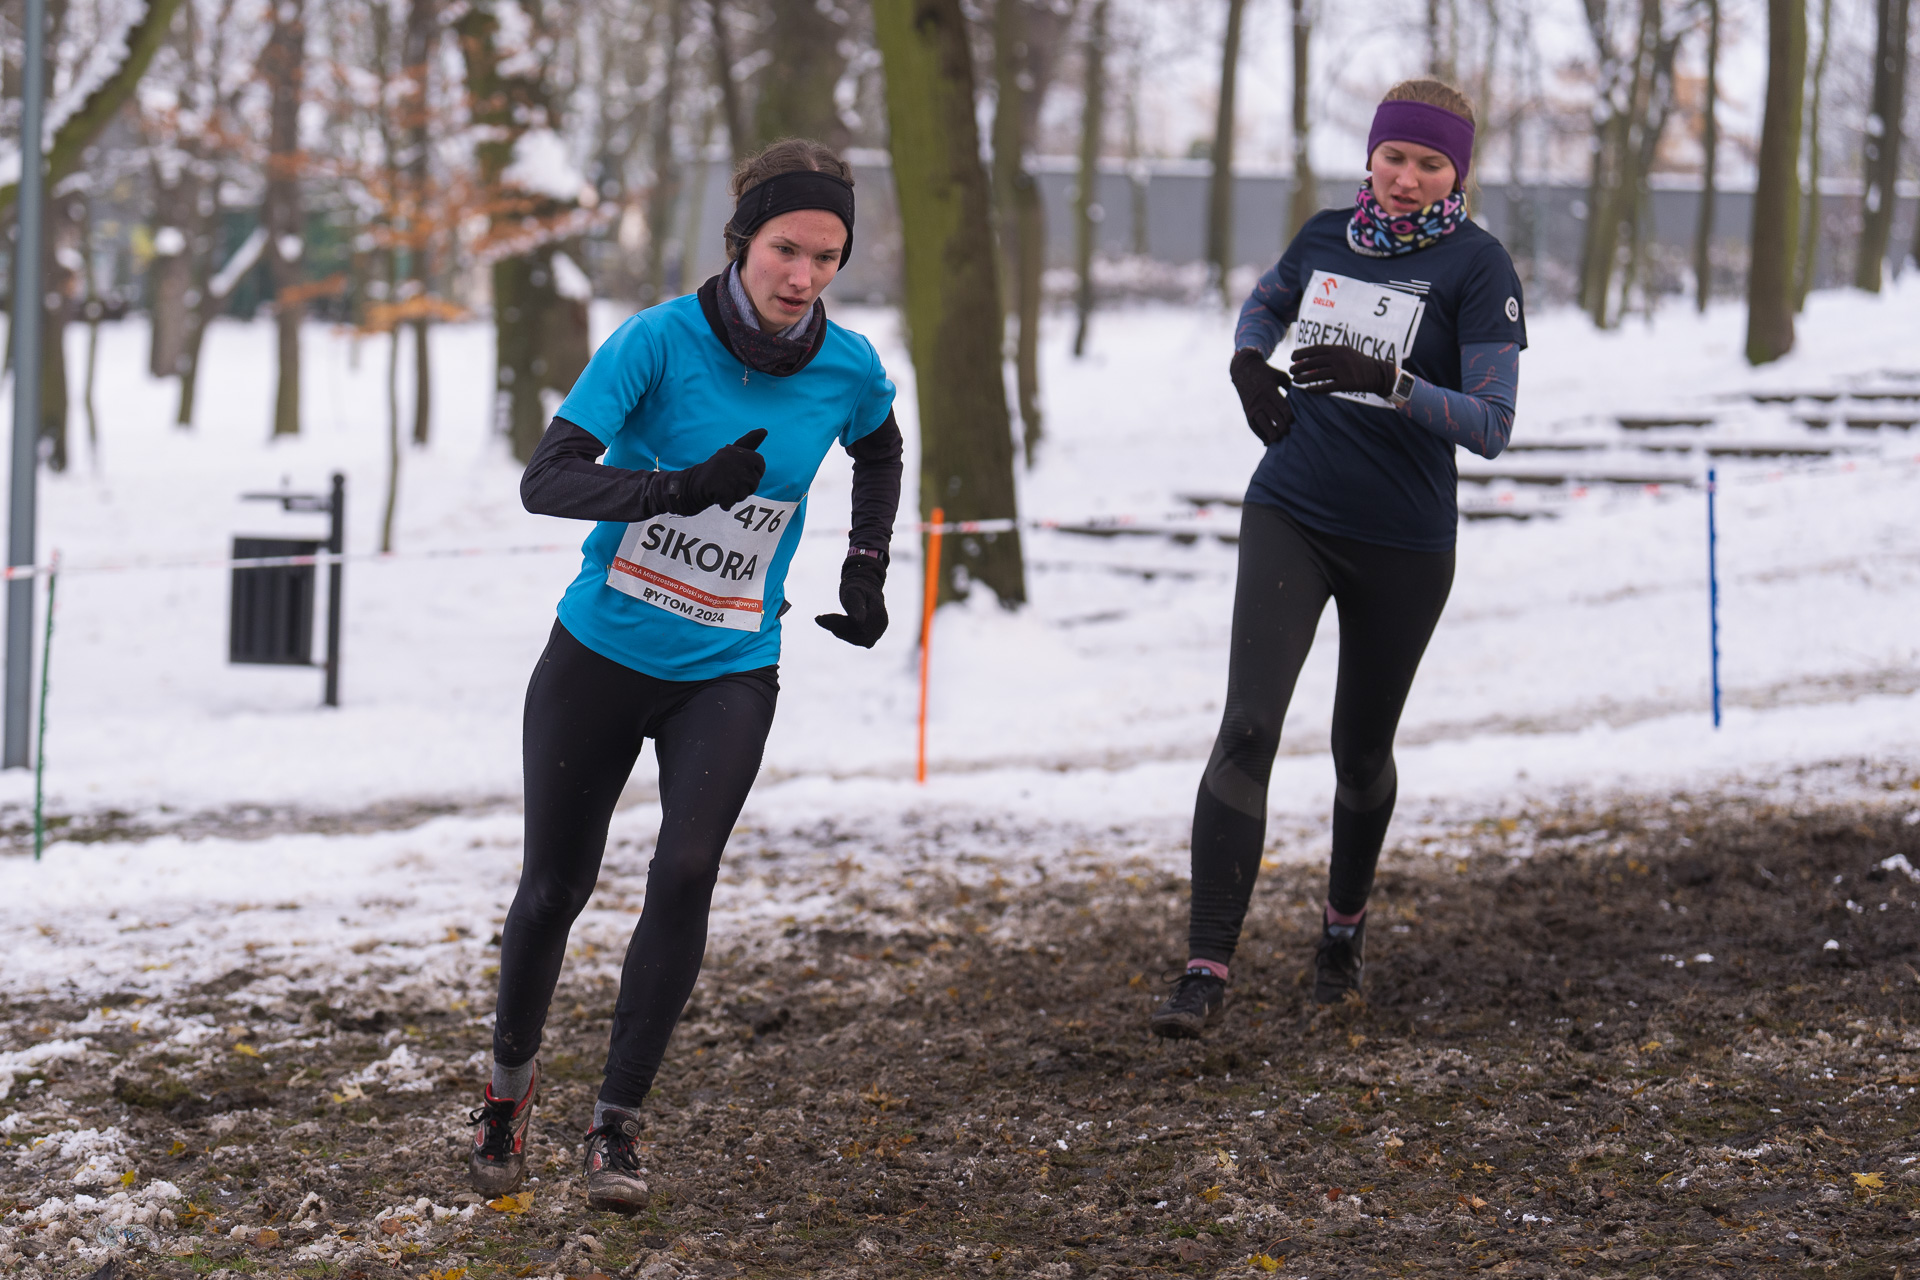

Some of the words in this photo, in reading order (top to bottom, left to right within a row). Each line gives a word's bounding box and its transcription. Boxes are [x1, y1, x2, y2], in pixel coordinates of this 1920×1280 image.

[1313, 296, 1336, 308] ORLEN
[1373, 296, 1391, 317] 5
[733, 504, 786, 533] 476
[640, 523, 758, 581] SIKORA
[642, 571, 679, 590] Mistrzostwa
[679, 585, 697, 597] Polski
[643, 587, 694, 615] BYTOM
[695, 608, 725, 623] 2024
